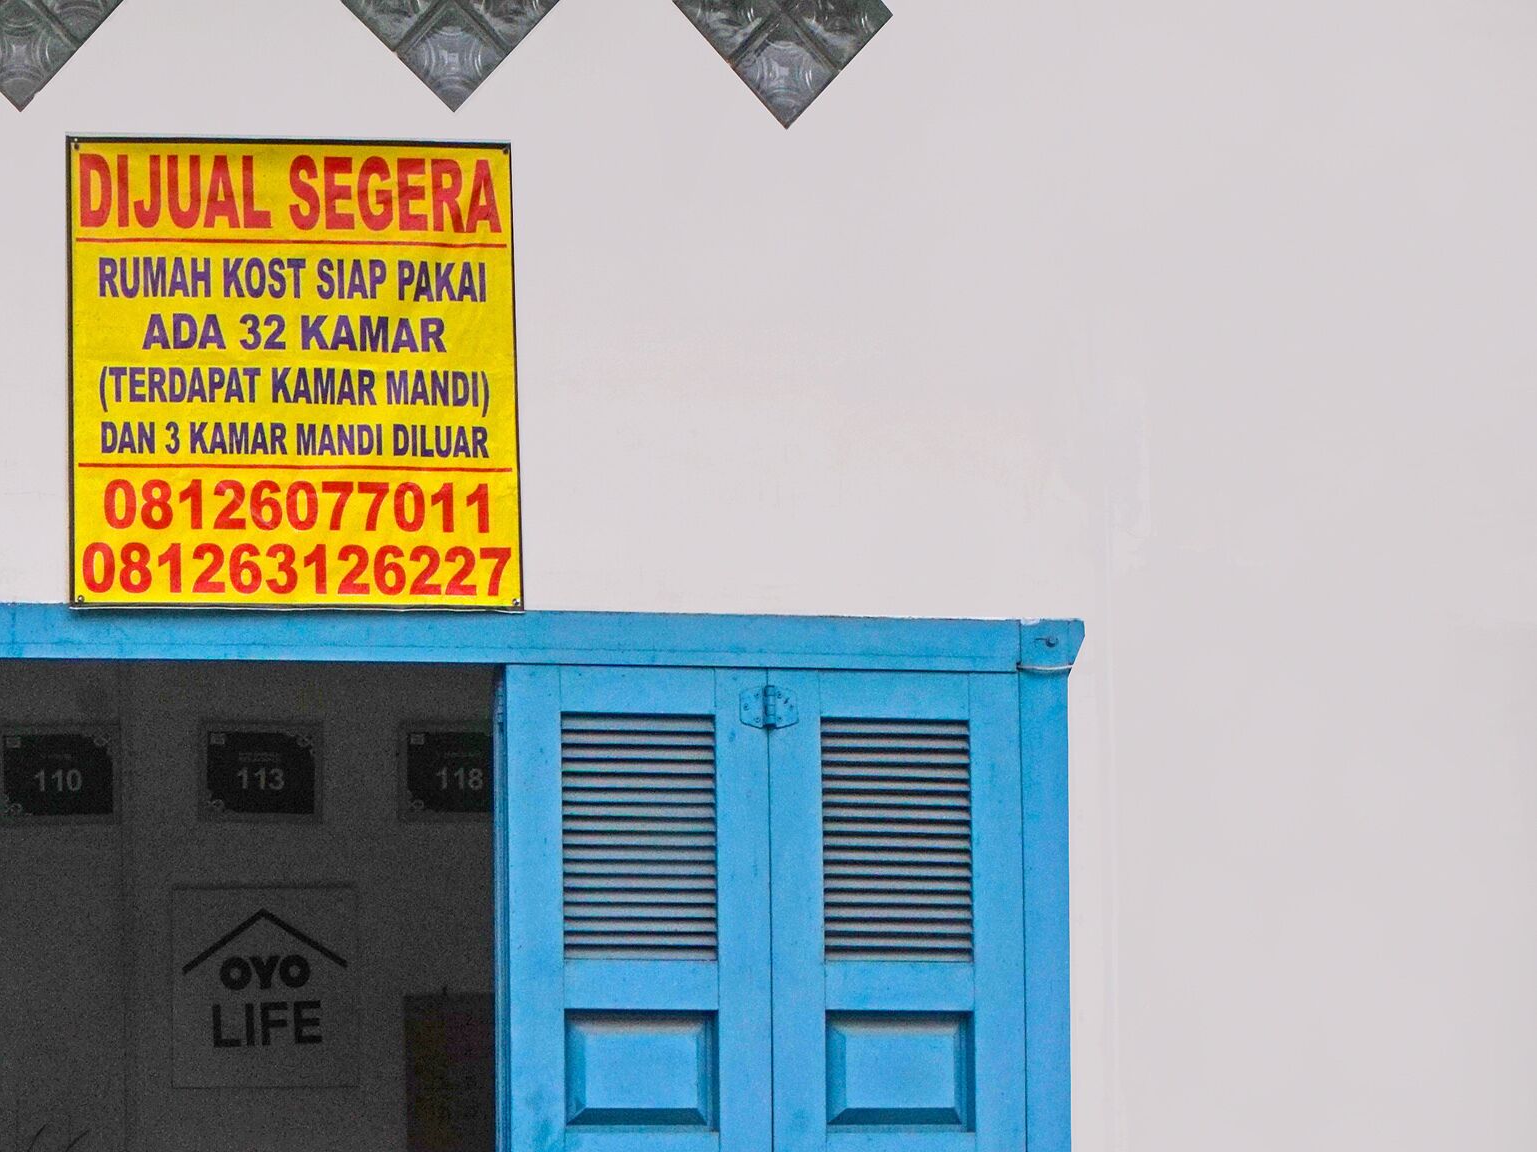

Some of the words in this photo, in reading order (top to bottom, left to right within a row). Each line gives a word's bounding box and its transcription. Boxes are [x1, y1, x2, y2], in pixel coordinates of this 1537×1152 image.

[78, 153, 272, 229] DIJUAL
[289, 155, 502, 233] SEGERA
[99, 256, 211, 298] RUMAH
[223, 257, 306, 300] KOST
[317, 258, 387, 301] SIAP
[399, 260, 487, 303] PAKAI
[142, 313, 226, 350] ADA
[239, 314, 286, 351] 32
[301, 315, 446, 354] KAMAR
[99, 366, 261, 412] (TERDAPAT
[271, 368, 376, 406] KAMAR
[386, 370, 490, 417] MANDI)
[101, 421, 155, 454] DAN
[165, 421, 181, 454] 3
[190, 422, 287, 456] KAMAR
[296, 423, 382, 457] MANDI
[393, 425, 490, 459] DILUAR
[103, 478, 490, 534] 08126077011
[82, 541, 512, 597] 081263126227
[34, 768, 83, 792] 110
[237, 766, 285, 791] 113
[435, 766, 484, 791] 118
[219, 954, 311, 990] OYO
[211, 1000, 323, 1048] LIFE
